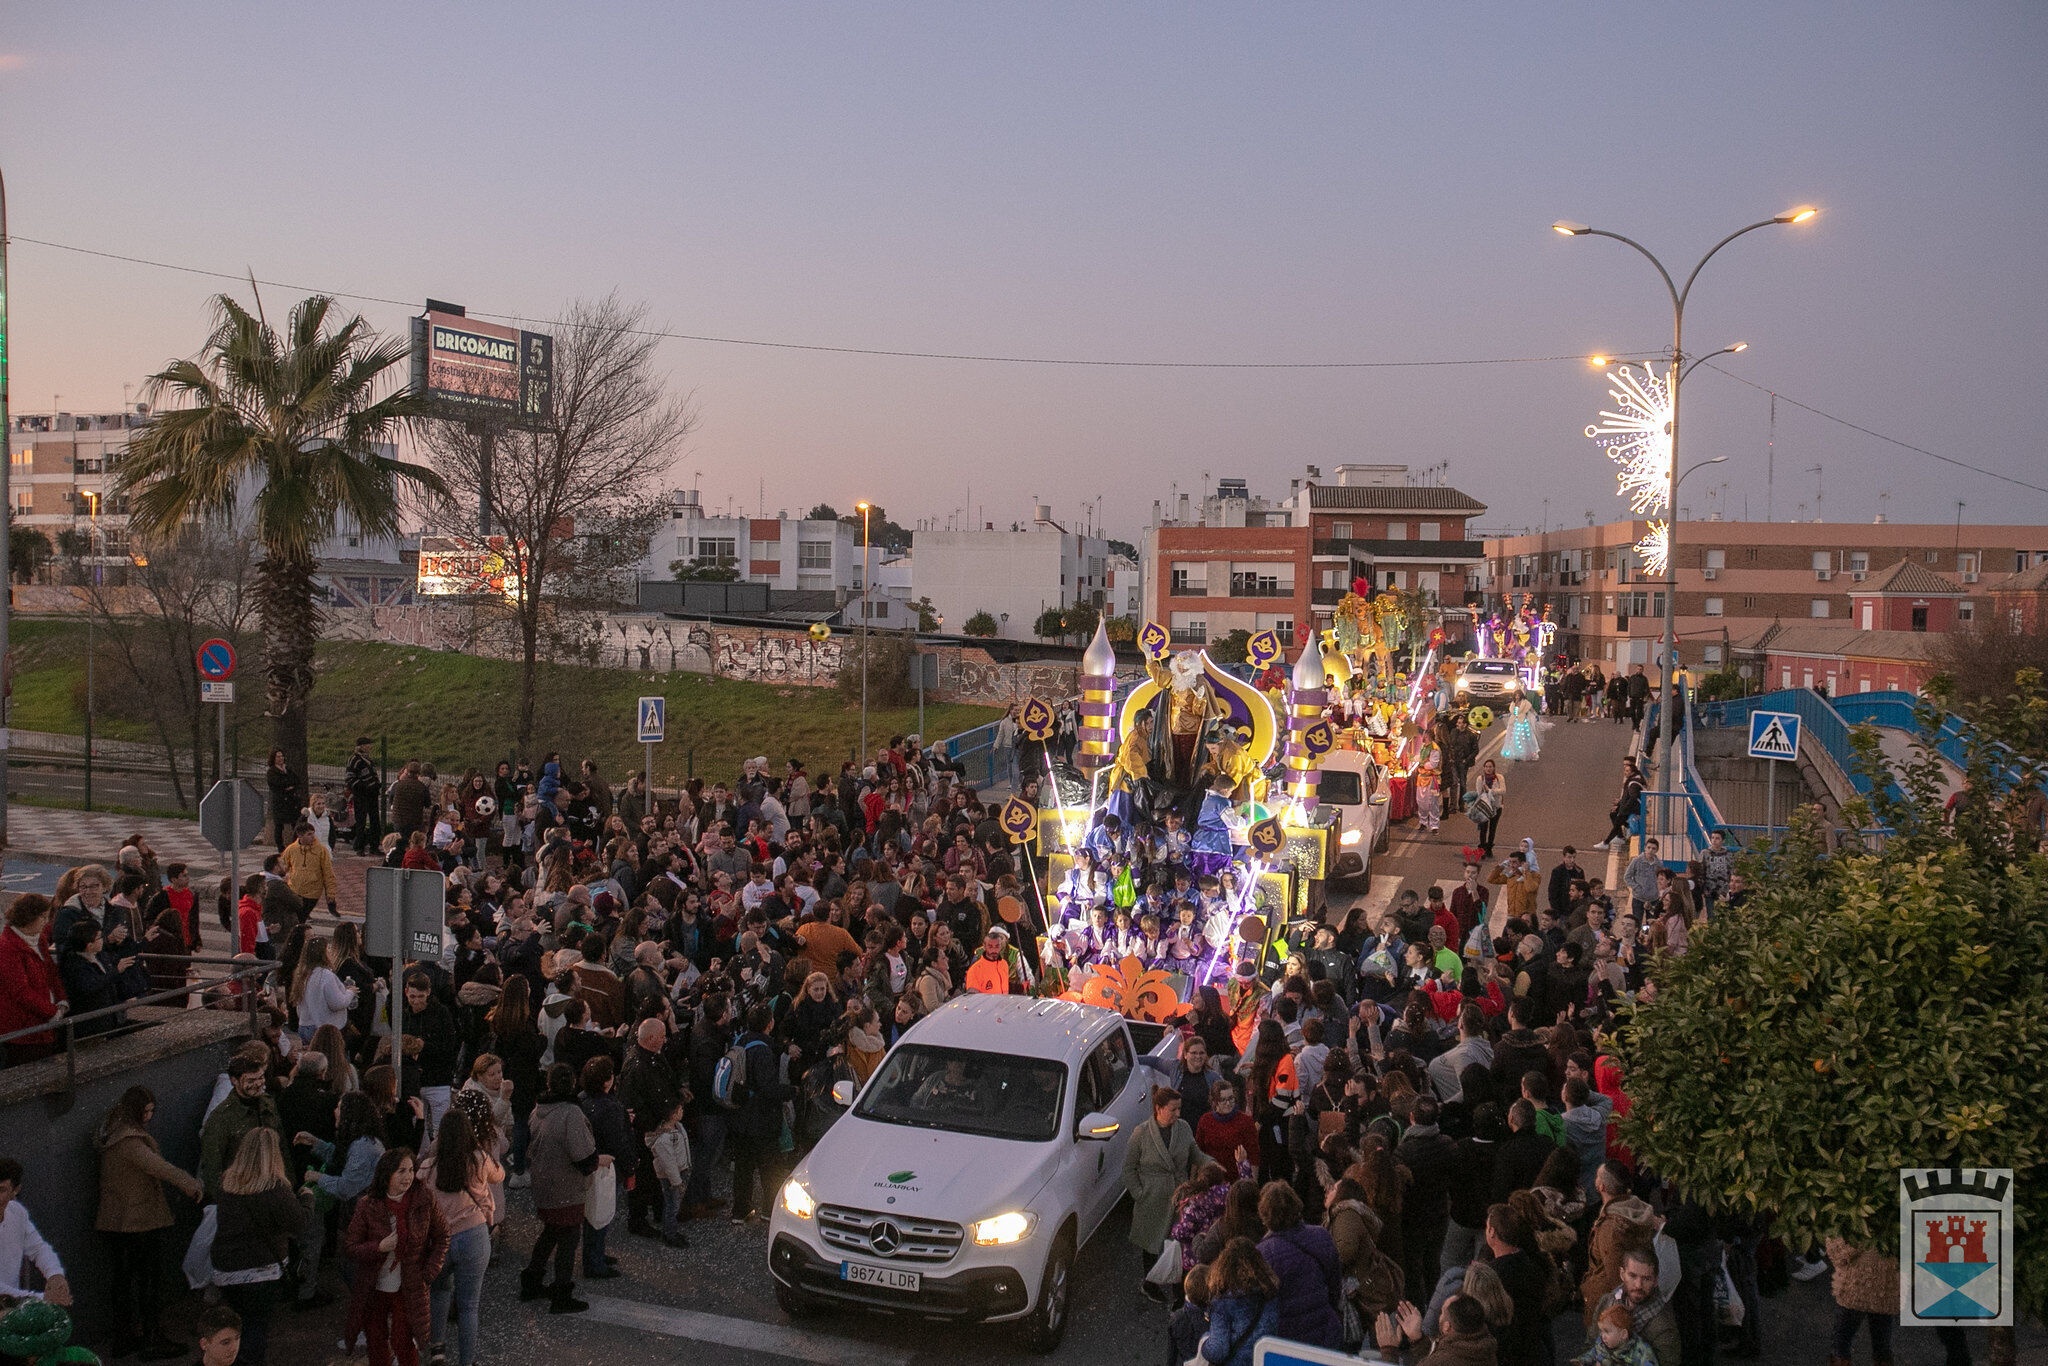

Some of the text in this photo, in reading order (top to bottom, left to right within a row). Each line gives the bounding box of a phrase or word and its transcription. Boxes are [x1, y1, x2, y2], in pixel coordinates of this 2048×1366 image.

[436, 331, 515, 361] BRICOMART
[530, 338, 544, 365] 5
[414, 932, 439, 944] LEÑA
[851, 1266, 916, 1289] 9674 LDR
